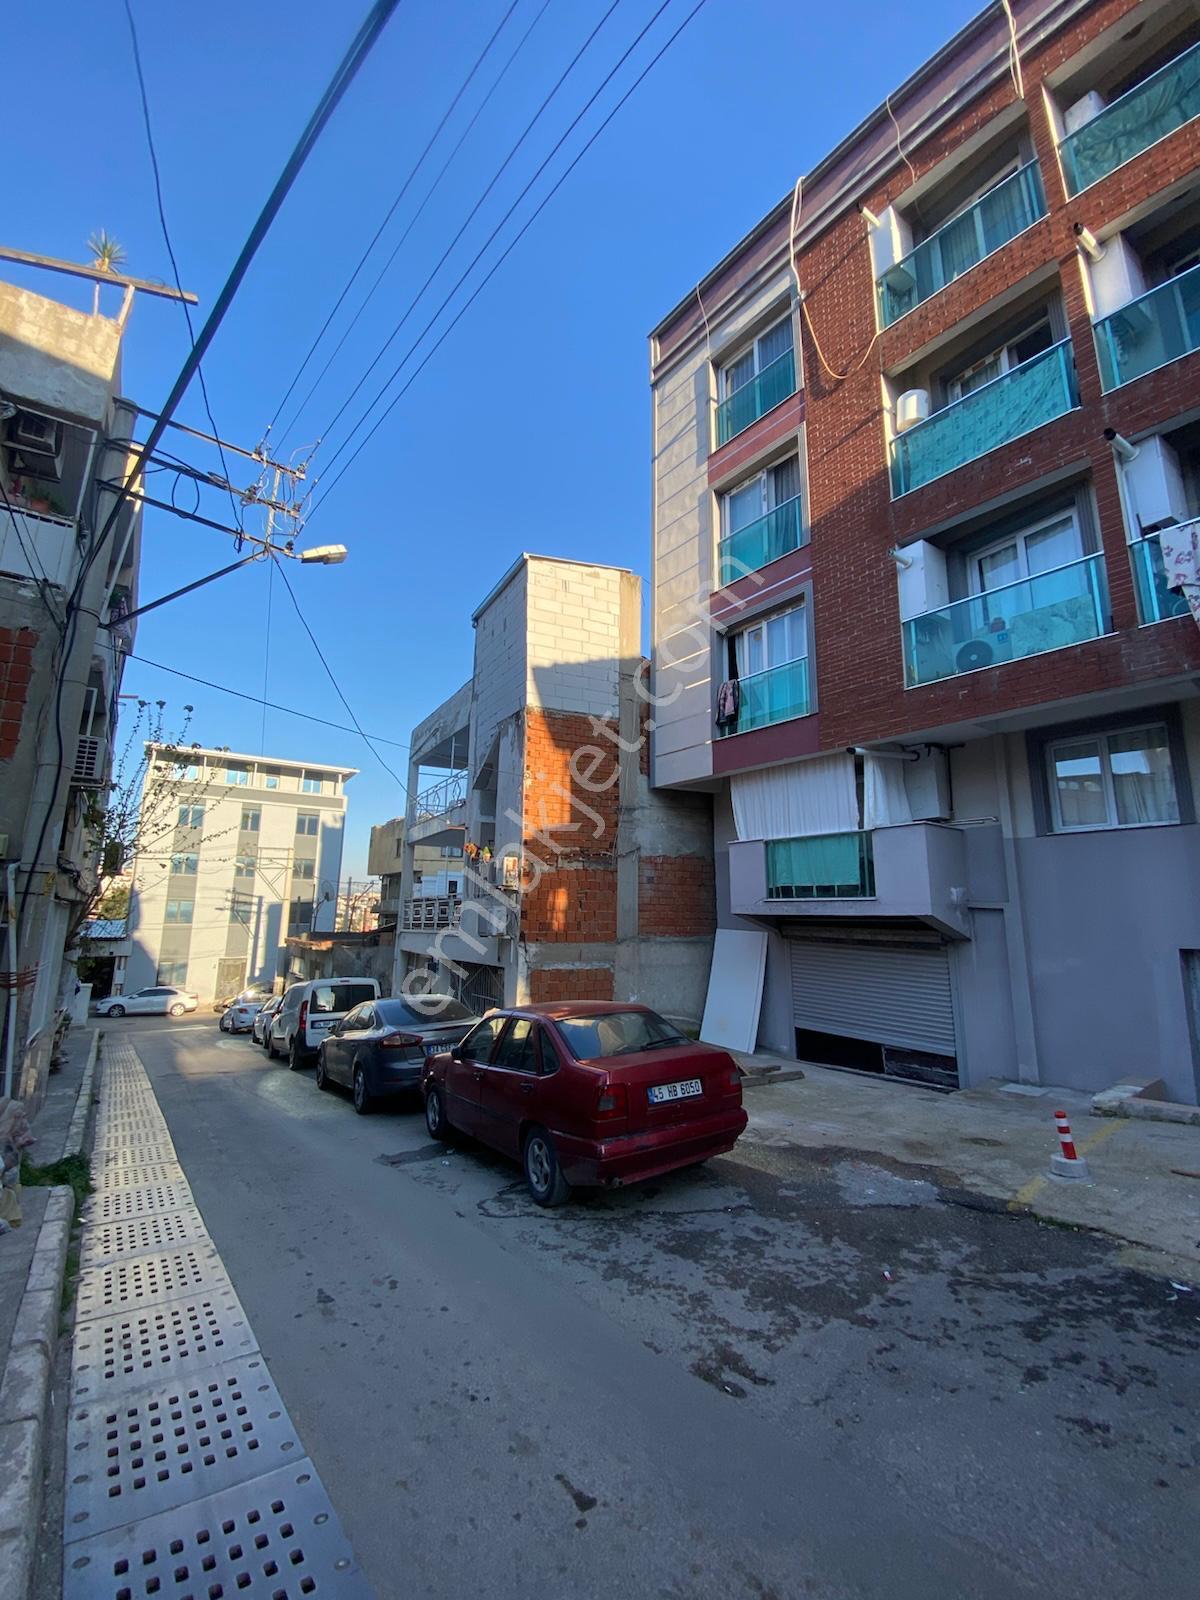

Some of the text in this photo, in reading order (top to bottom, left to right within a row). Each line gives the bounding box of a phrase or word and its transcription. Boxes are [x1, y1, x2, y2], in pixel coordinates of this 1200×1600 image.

[653, 1080, 701, 1101] 45 HB 6050
